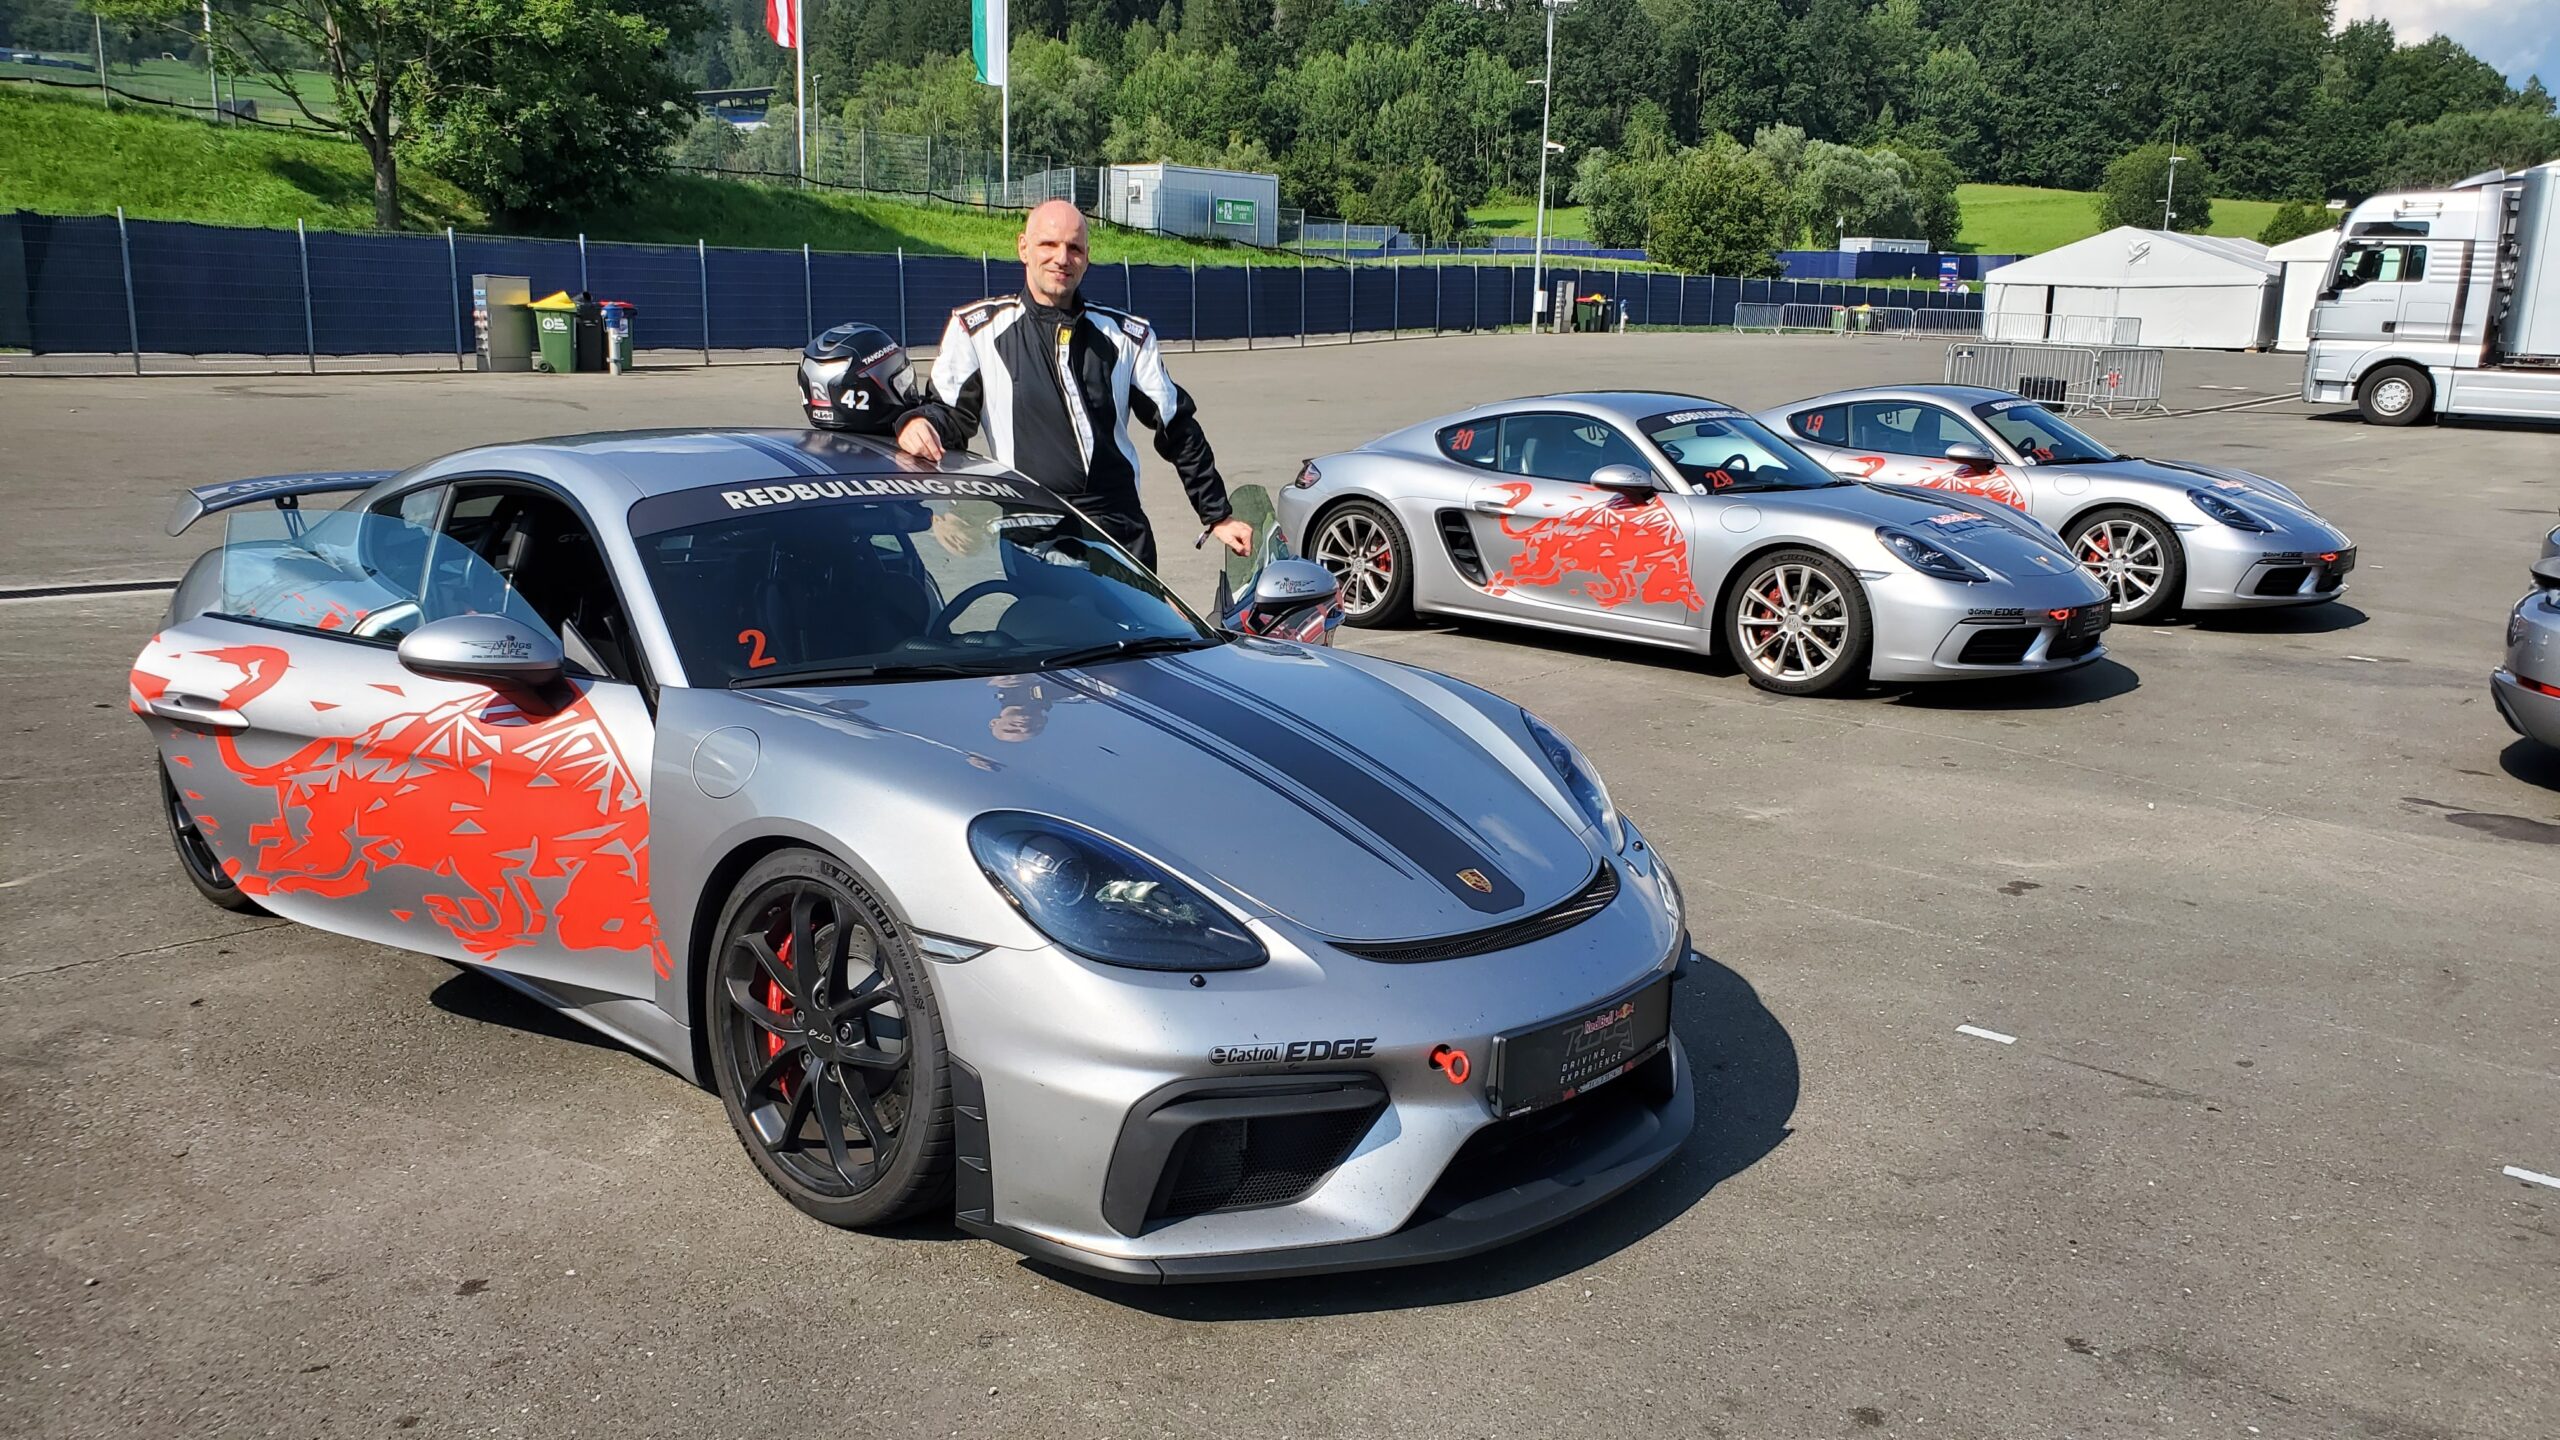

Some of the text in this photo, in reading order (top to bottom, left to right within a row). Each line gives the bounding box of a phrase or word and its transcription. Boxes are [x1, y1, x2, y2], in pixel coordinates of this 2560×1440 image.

[966, 311, 988, 328] OMP
[1123, 319, 1145, 338] OMP
[841, 389, 870, 410] 42
[1806, 414, 1824, 431] 19
[1452, 429, 1474, 450] 20
[1705, 469, 1734, 488] 20
[721, 479, 1024, 510] REDBULLRING.COM
[1994, 607, 2025, 616] EDGE
[738, 629, 777, 669] 2
[835, 871, 896, 936] MICHELIN
[808, 1028, 832, 1044] GT4
[1227, 1036, 1378, 1063] Castrol EDGE
[1559, 1051, 1623, 1085] EXPERIENCE
[1561, 1048, 1606, 1073] DRIVING
